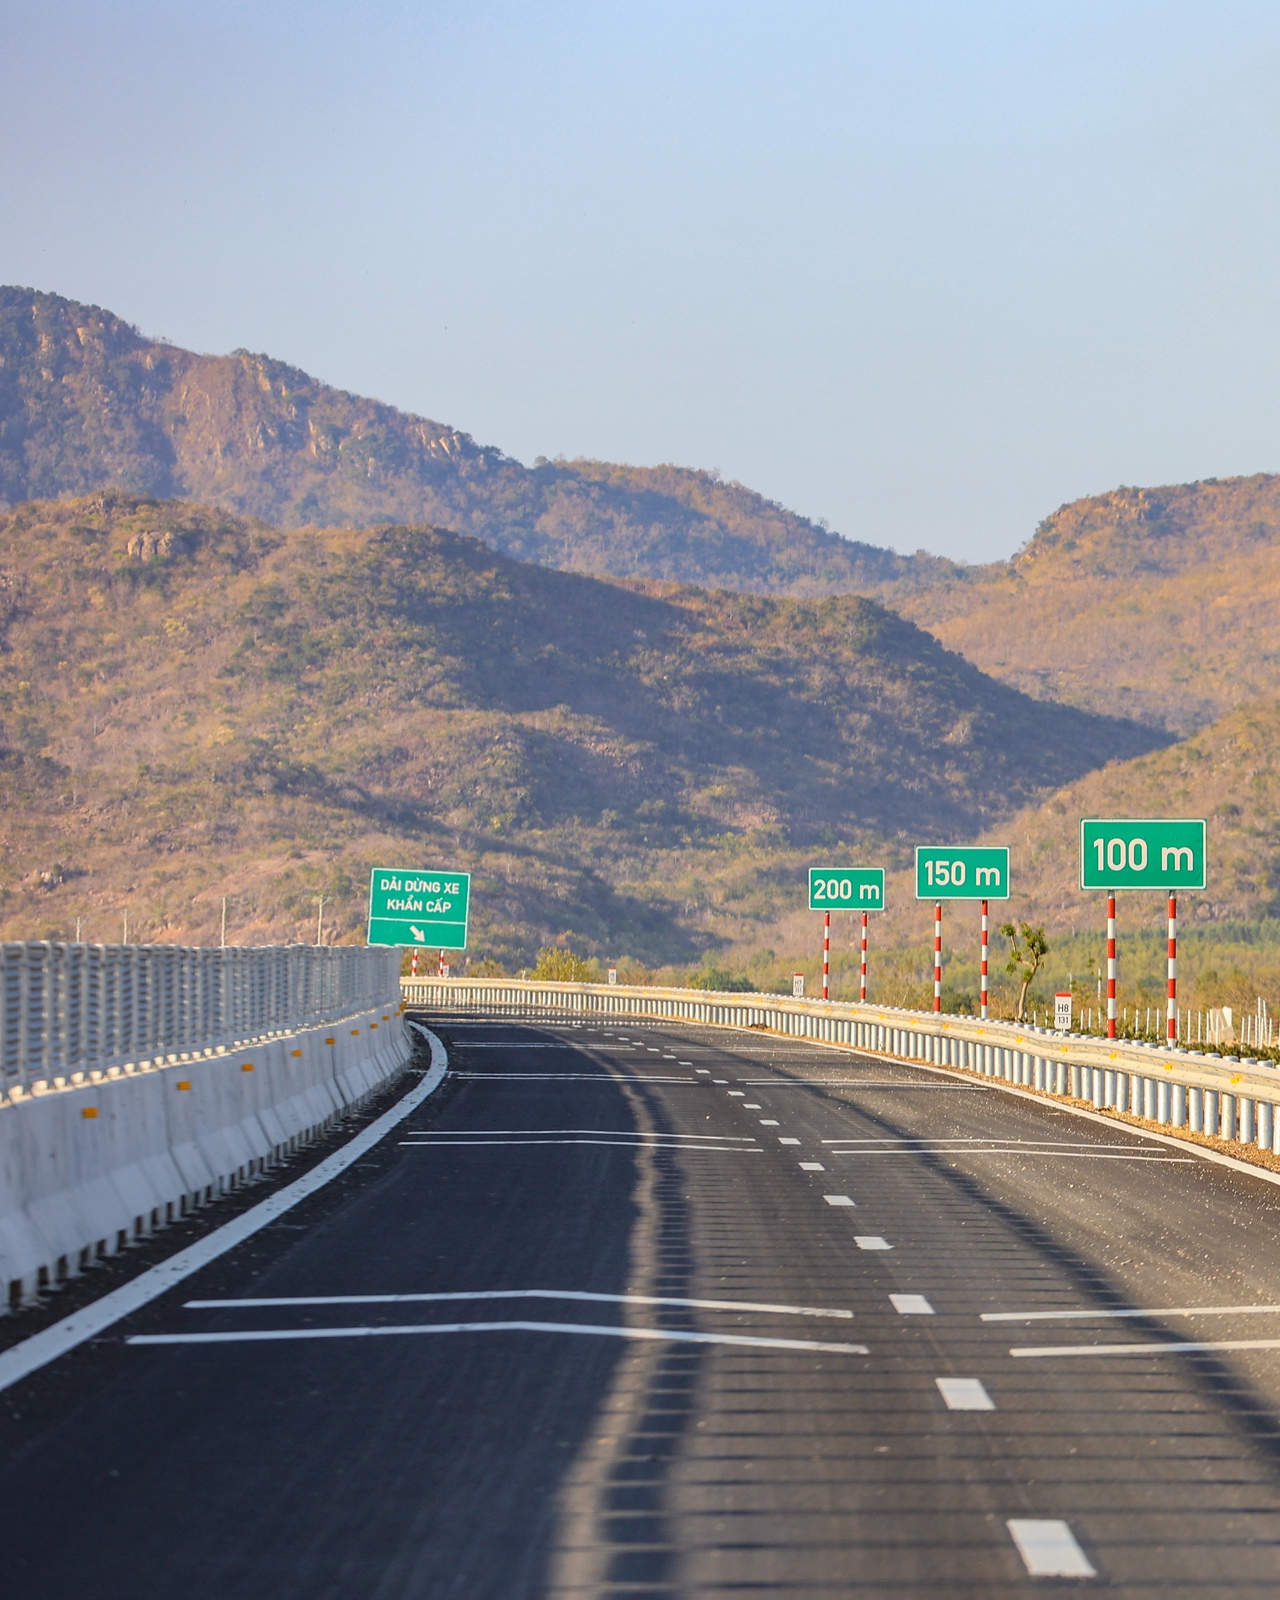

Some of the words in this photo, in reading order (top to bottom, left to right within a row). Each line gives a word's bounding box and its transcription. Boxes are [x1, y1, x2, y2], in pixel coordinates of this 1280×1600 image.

[1093, 837, 1148, 872] 100
[1161, 846, 1194, 871] m
[924, 860, 966, 886] 150
[975, 867, 1001, 886] m
[380, 876, 402, 891] DẢI
[404, 877, 441, 893] DỪNG
[443, 882, 460, 895] XE
[813, 878, 852, 900] 200
[859, 884, 880, 900] m
[386, 894, 423, 911] KHẨN
[425, 897, 452, 913] CẤP
[1057, 1003, 1069, 1012] H8
[1058, 1016, 1069, 1024] 131
